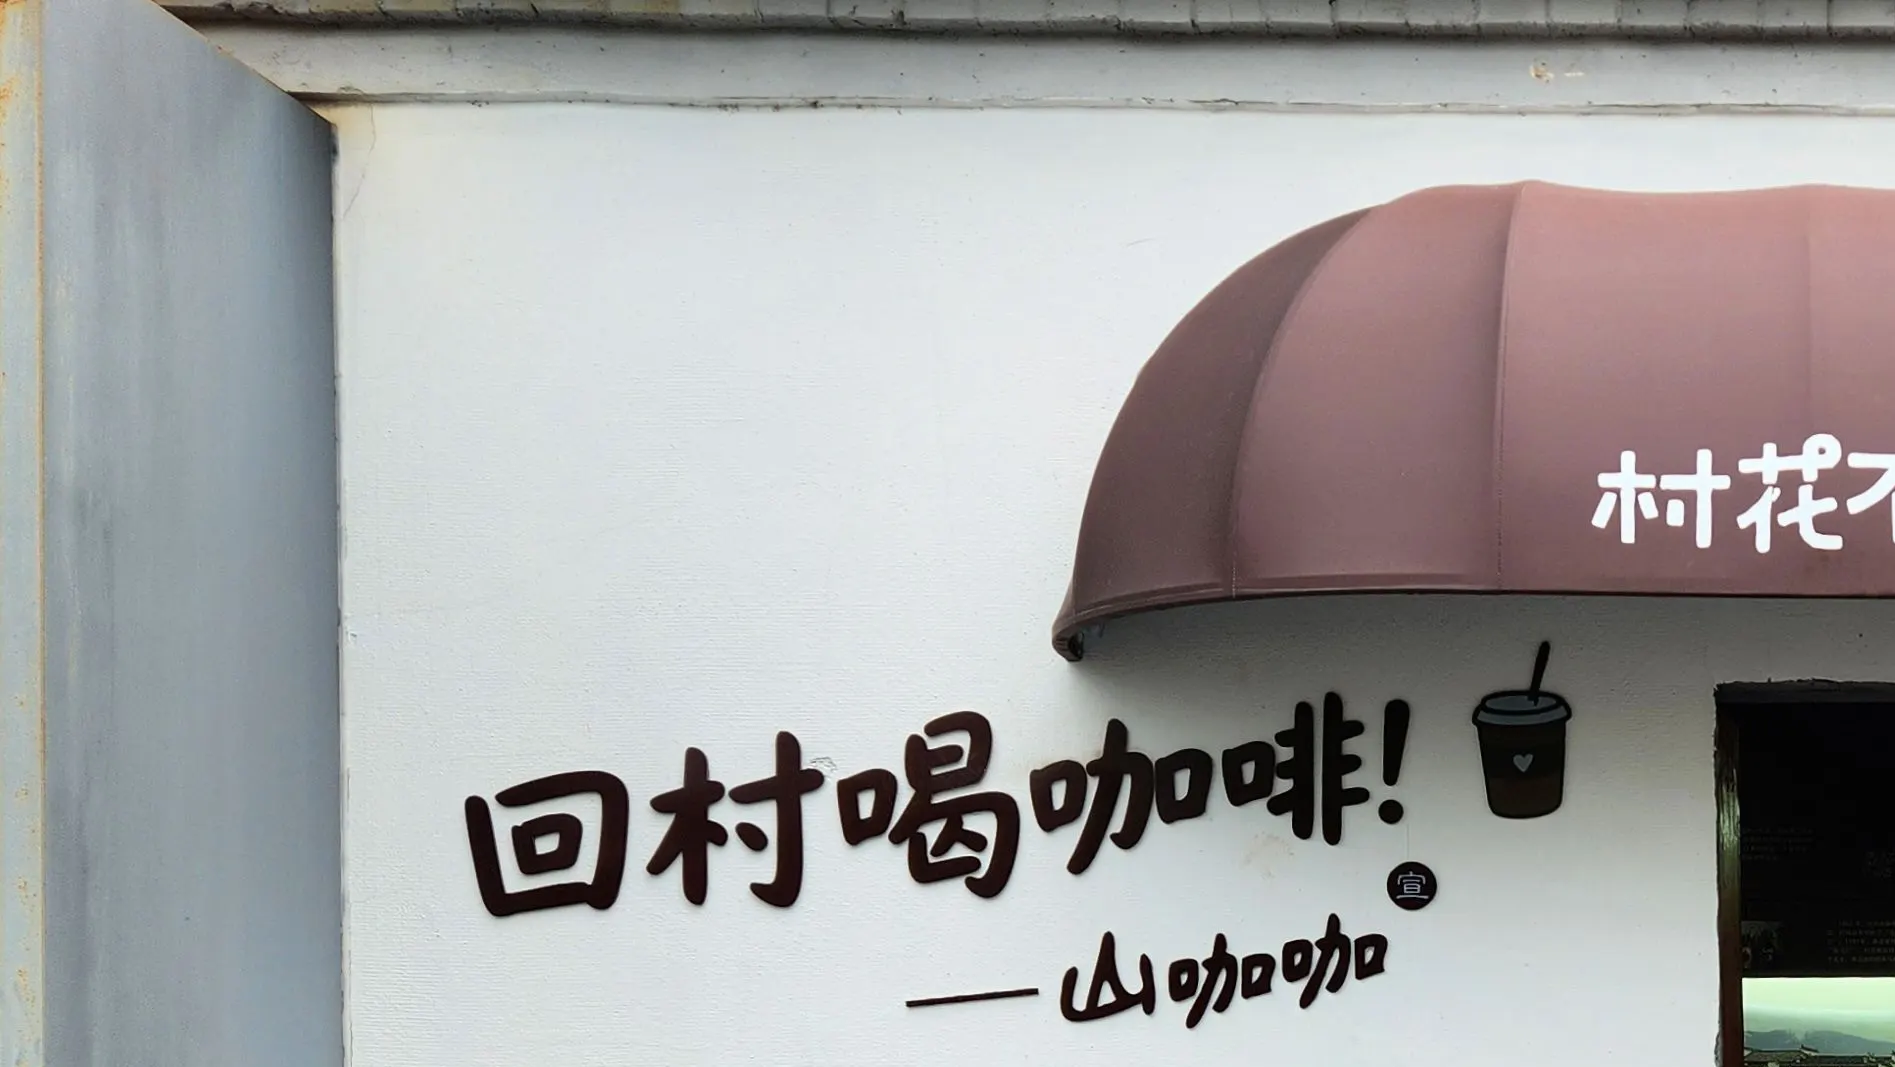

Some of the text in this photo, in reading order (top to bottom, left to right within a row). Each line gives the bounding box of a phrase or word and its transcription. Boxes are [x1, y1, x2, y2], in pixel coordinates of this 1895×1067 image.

[464, 688, 1412, 918] 回村喝咖啡!
[1395, 870, 1429, 899] 宣
